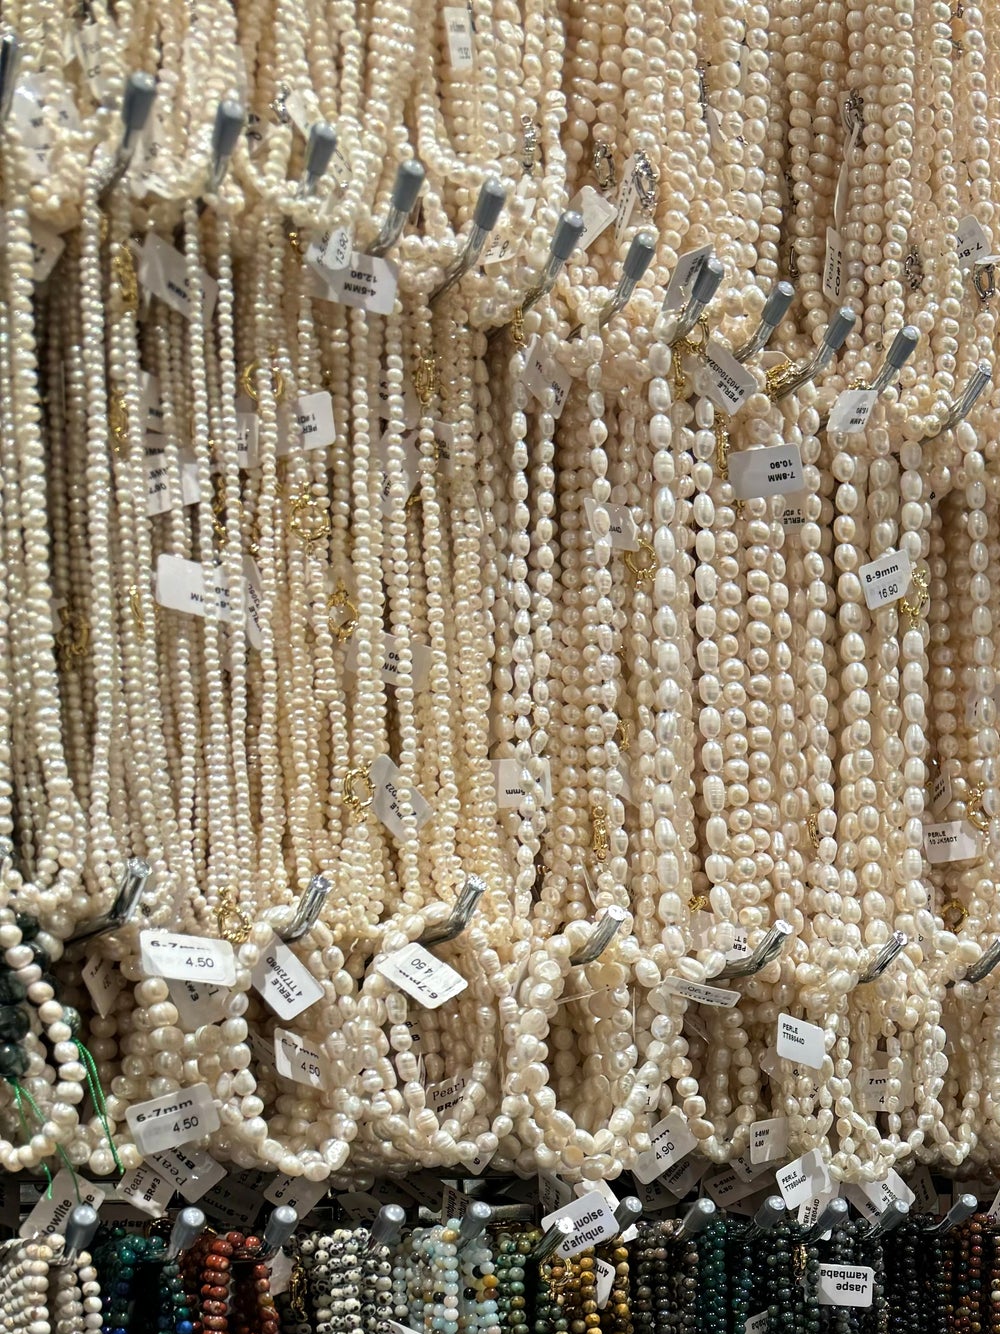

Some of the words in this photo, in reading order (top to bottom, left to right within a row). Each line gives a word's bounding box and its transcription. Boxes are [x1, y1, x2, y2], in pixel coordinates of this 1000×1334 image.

[770, 459, 793, 470] 10.90
[866, 563, 899, 584] 8-9mm
[878, 583, 899, 600] 16.90
[927, 830, 946, 838] PERLE
[185, 956, 215, 968] 4.50
[410, 959, 436, 979] 4.50
[269, 977, 294, 1003] PERLE
[301, 1062, 321, 1076] 4.50
[432, 1078, 467, 1101] Pearl
[135, 1099, 194, 1122] 6-7mm
[172, 1116, 200, 1133] 4.50
[655, 1141, 675, 1161] 4.90
[153, 1154, 188, 1186] Pear
[782, 1170, 798, 1185] PERLE
[124, 1167, 147, 1198] Pearl
[143, 1177, 161, 1202] BR#3
[571, 1207, 605, 1235] quoise
[562, 1224, 605, 1253] d'afrique
[820, 1268, 868, 1282] kambaba
[835, 1282, 868, 1293] Jaspe
